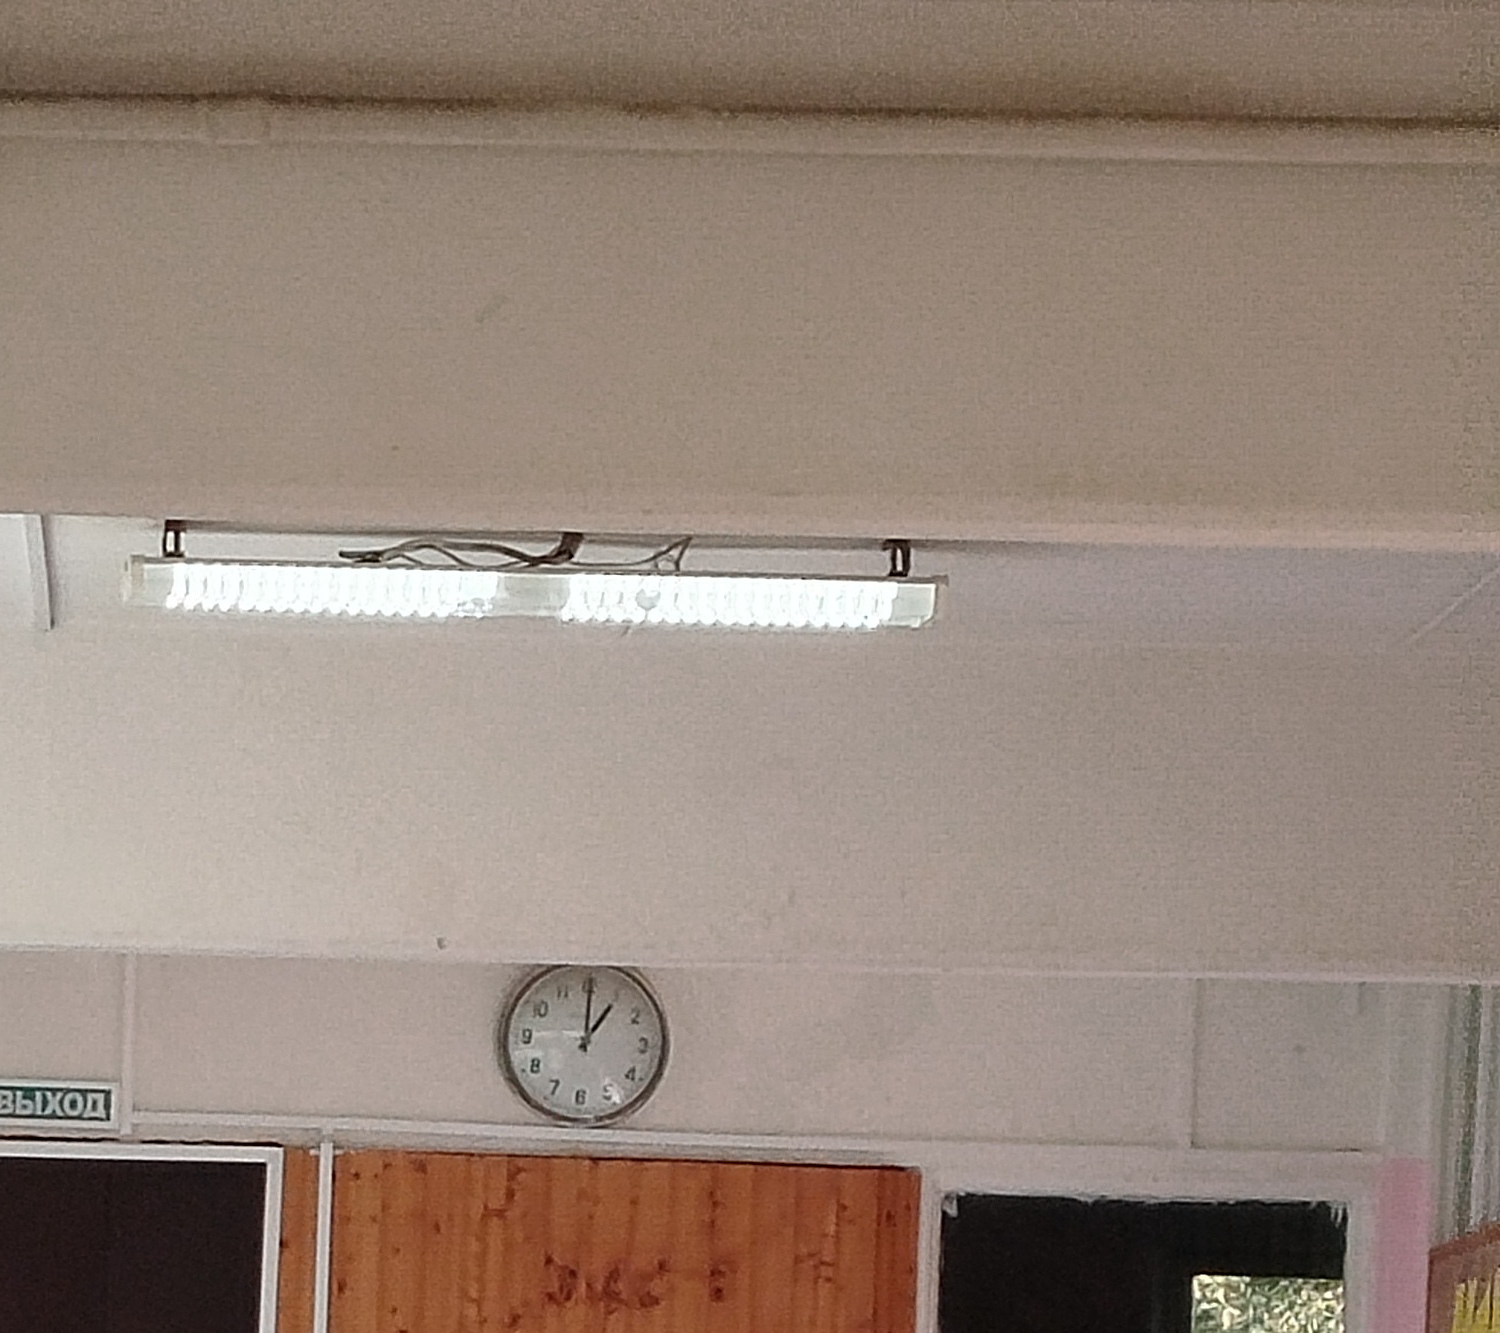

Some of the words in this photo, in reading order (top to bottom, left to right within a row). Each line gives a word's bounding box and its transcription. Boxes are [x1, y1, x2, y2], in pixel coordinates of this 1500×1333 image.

[533, 1001, 549, 1018] 10
[630, 1008, 640, 1025] 2
[522, 1028, 533, 1045] 9
[638, 1037, 649, 1054] 3
[530, 1058, 541, 1074] 8
[625, 1066, 637, 1082] 4
[549, 1079, 561, 1096] 7
[603, 1083, 615, 1101] 5
[575, 1088, 587, 1105] 6
